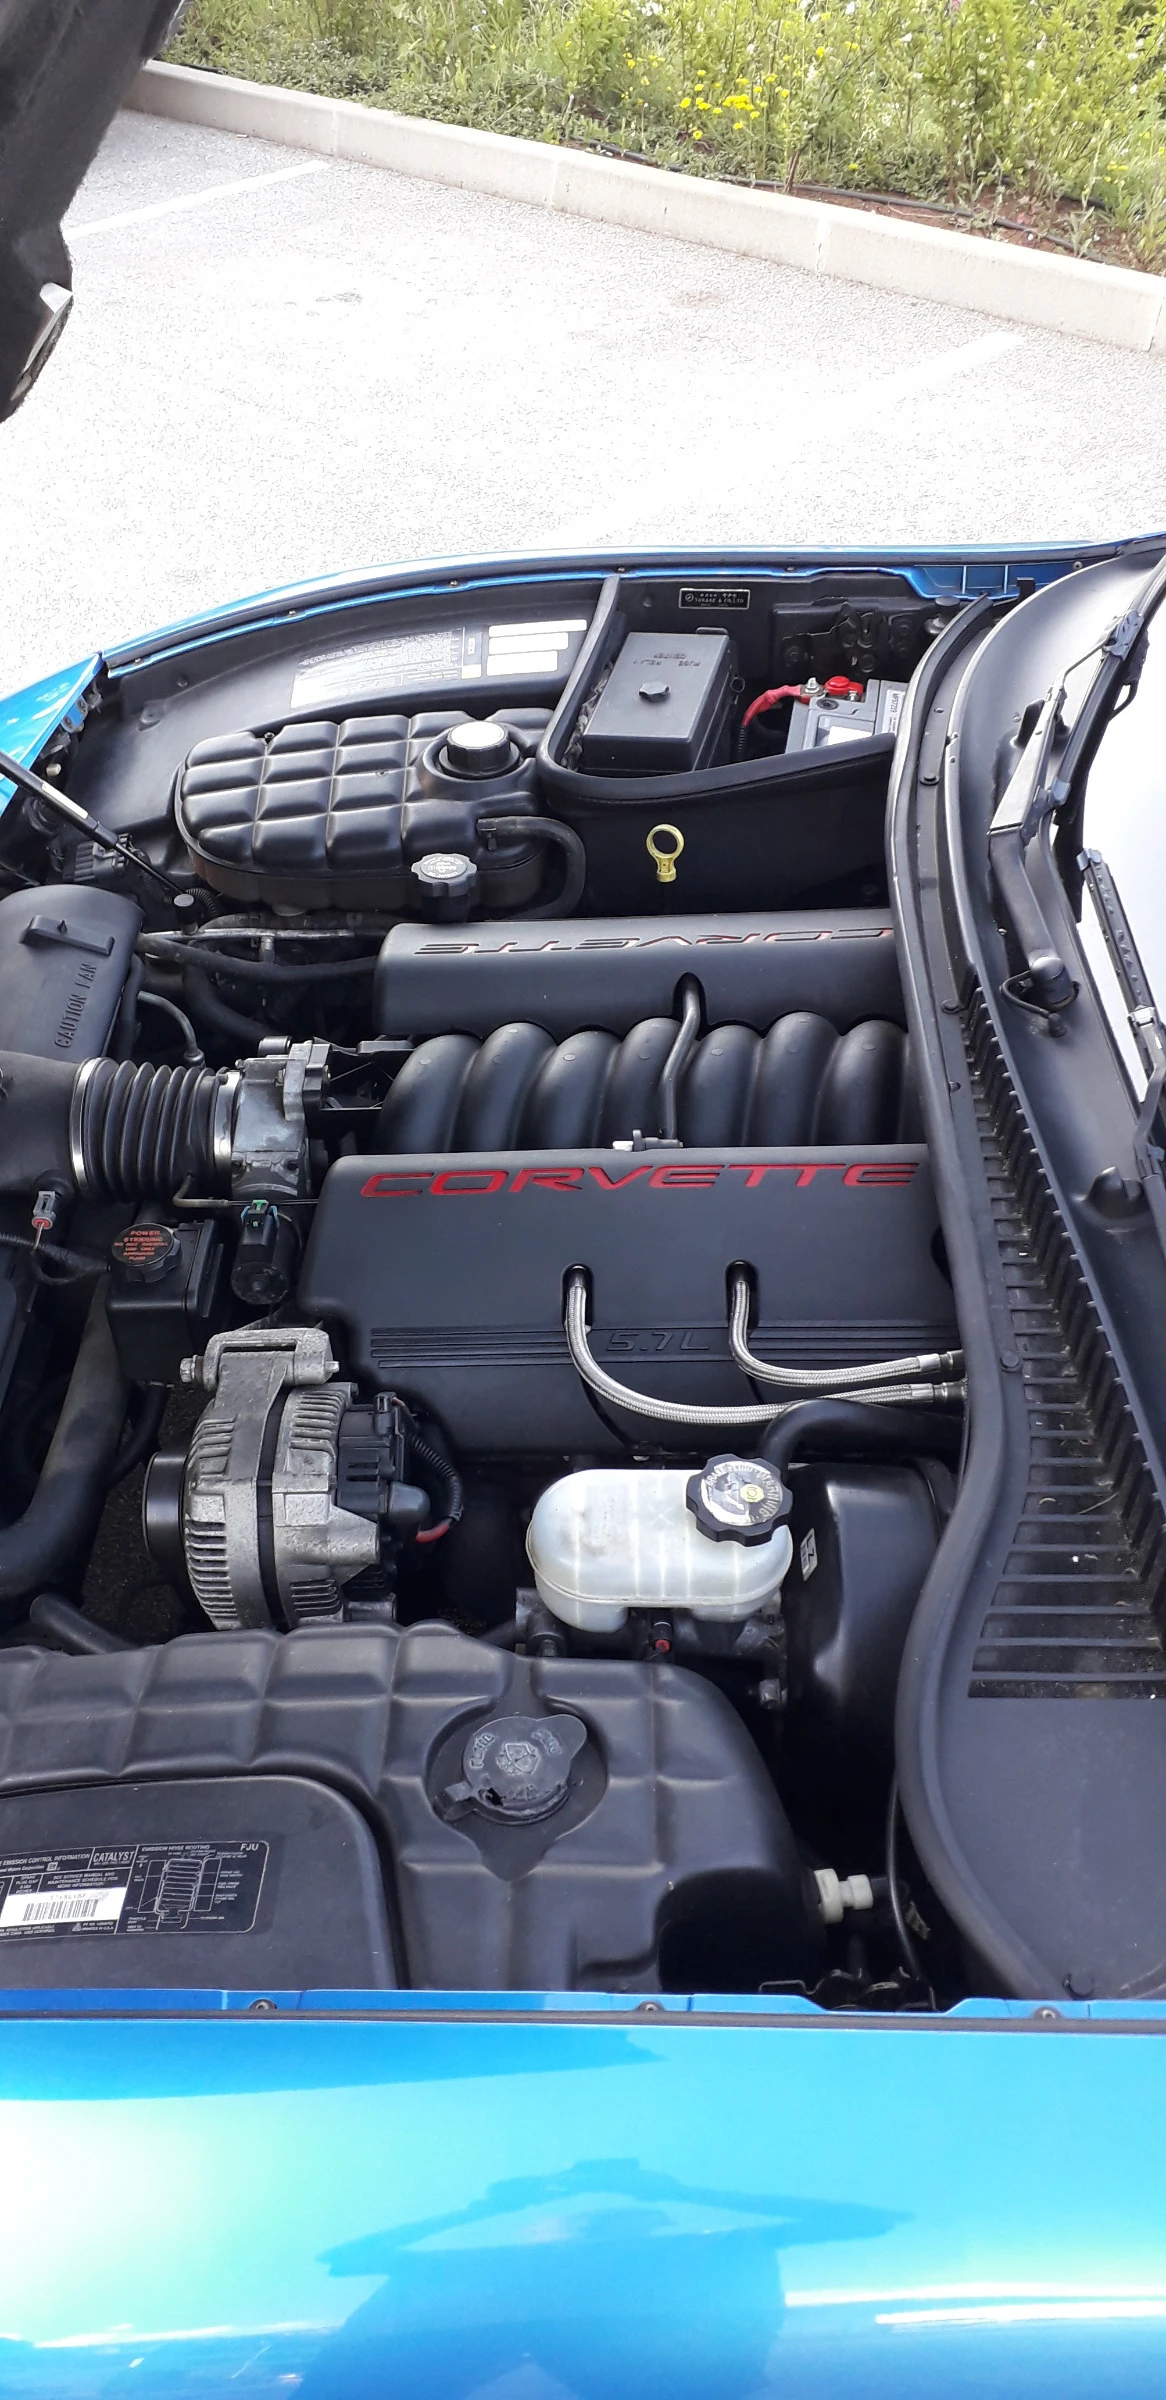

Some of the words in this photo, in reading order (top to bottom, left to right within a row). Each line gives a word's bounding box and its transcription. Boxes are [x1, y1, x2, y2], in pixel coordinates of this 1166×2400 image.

[414, 927, 894, 955] CORVETTE
[54, 994, 87, 1049] CAUTION
[361, 1163, 918, 1198] CORVETTE
[606, 1331, 710, 1352] 5.7L
[93, 1851, 136, 1861] CATALYST
[240, 1843, 259, 1851] FJU
